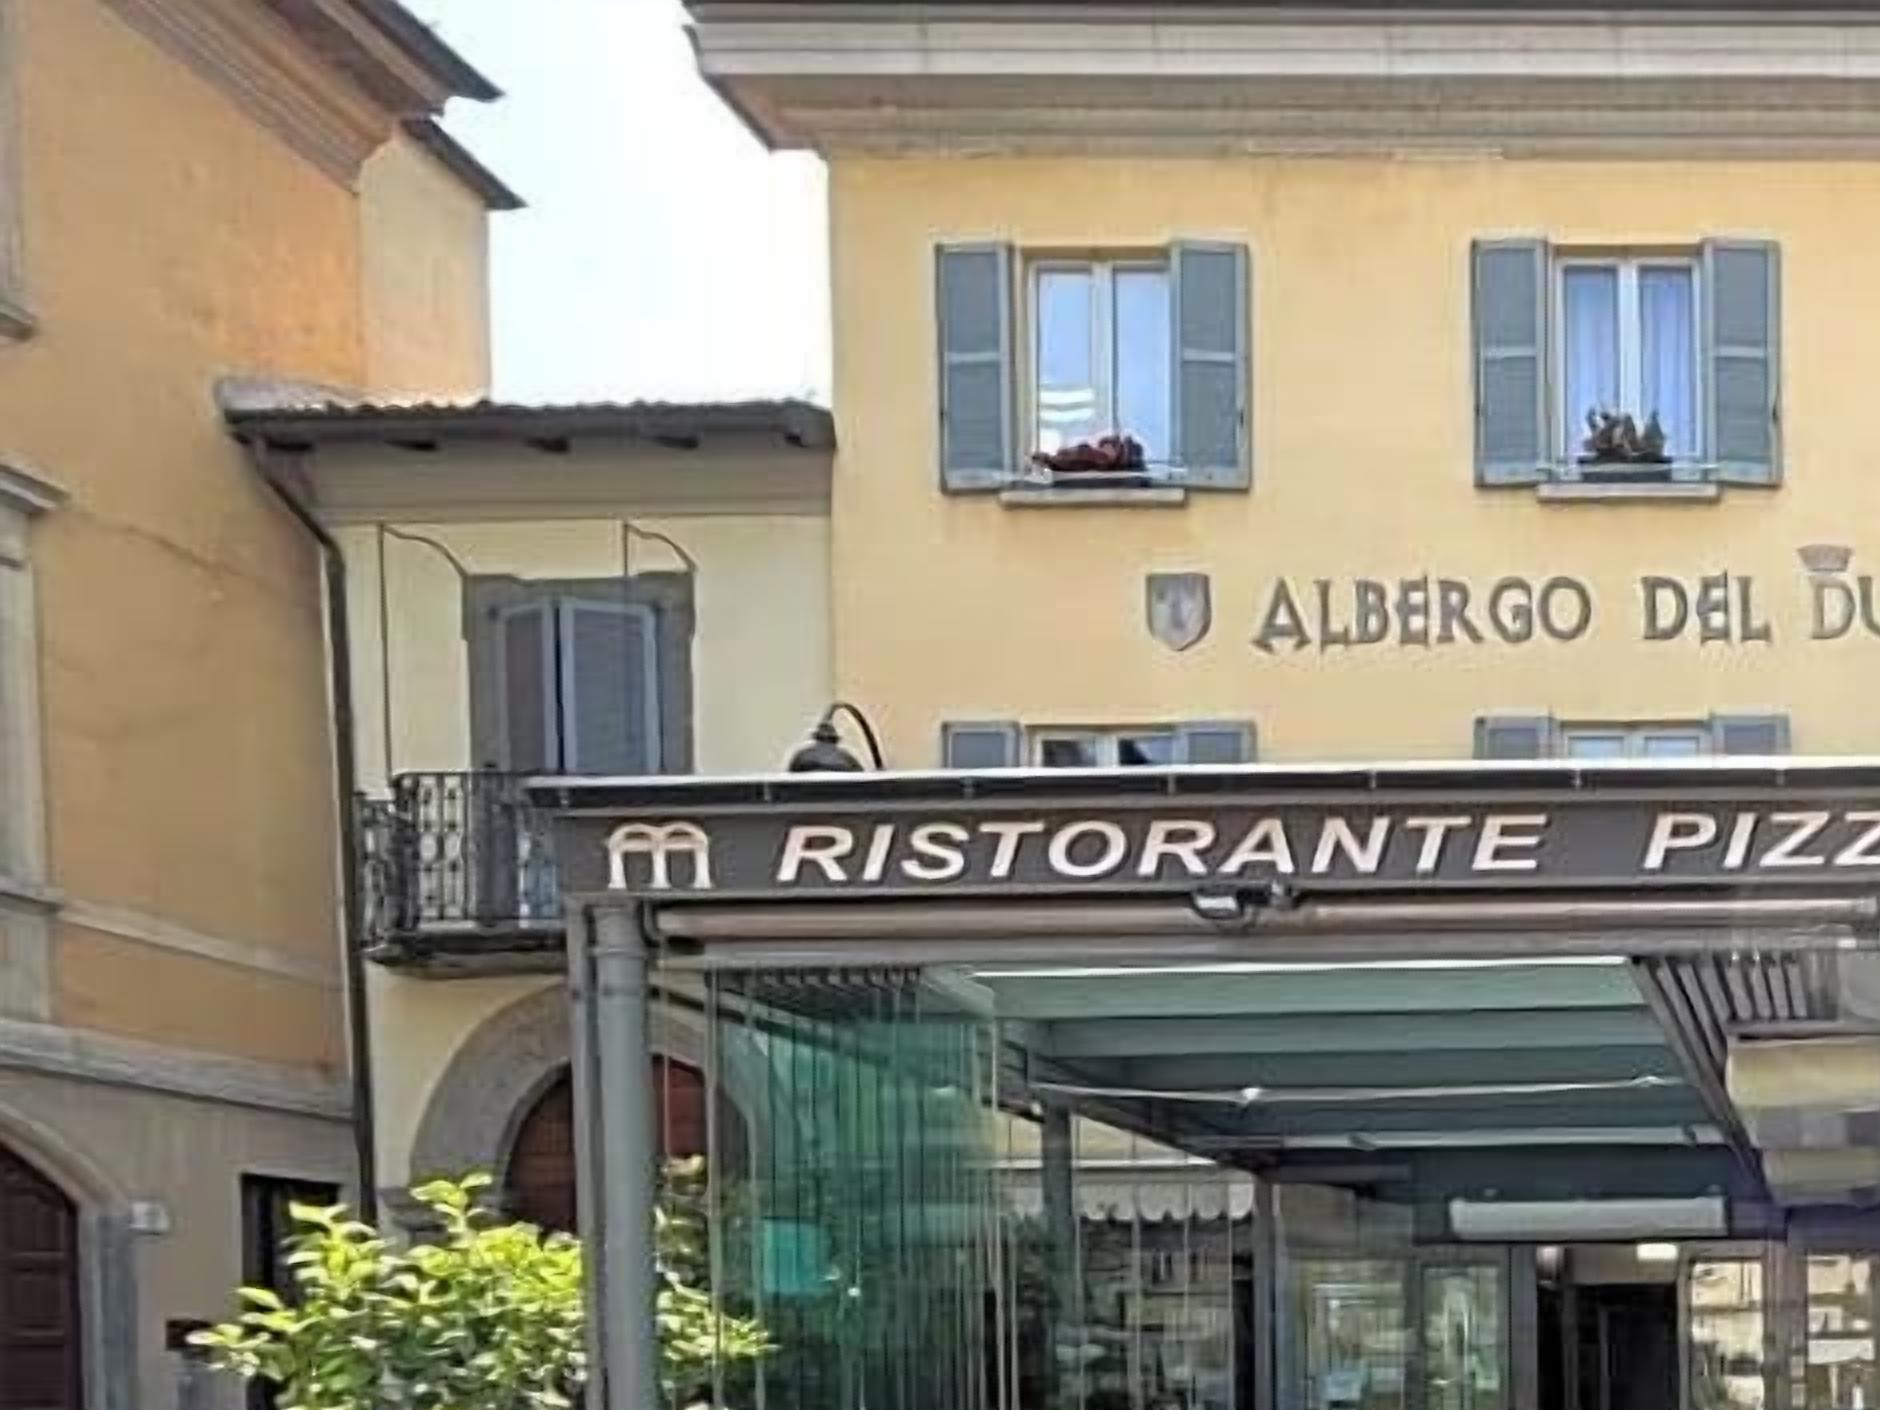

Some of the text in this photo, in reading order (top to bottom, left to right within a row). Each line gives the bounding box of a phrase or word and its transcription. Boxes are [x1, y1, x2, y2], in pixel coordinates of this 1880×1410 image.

[1250, 574, 1592, 654] ALBERGO
[1639, 571, 1773, 645] DEL
[777, 814, 1548, 882] RISTORANTE
